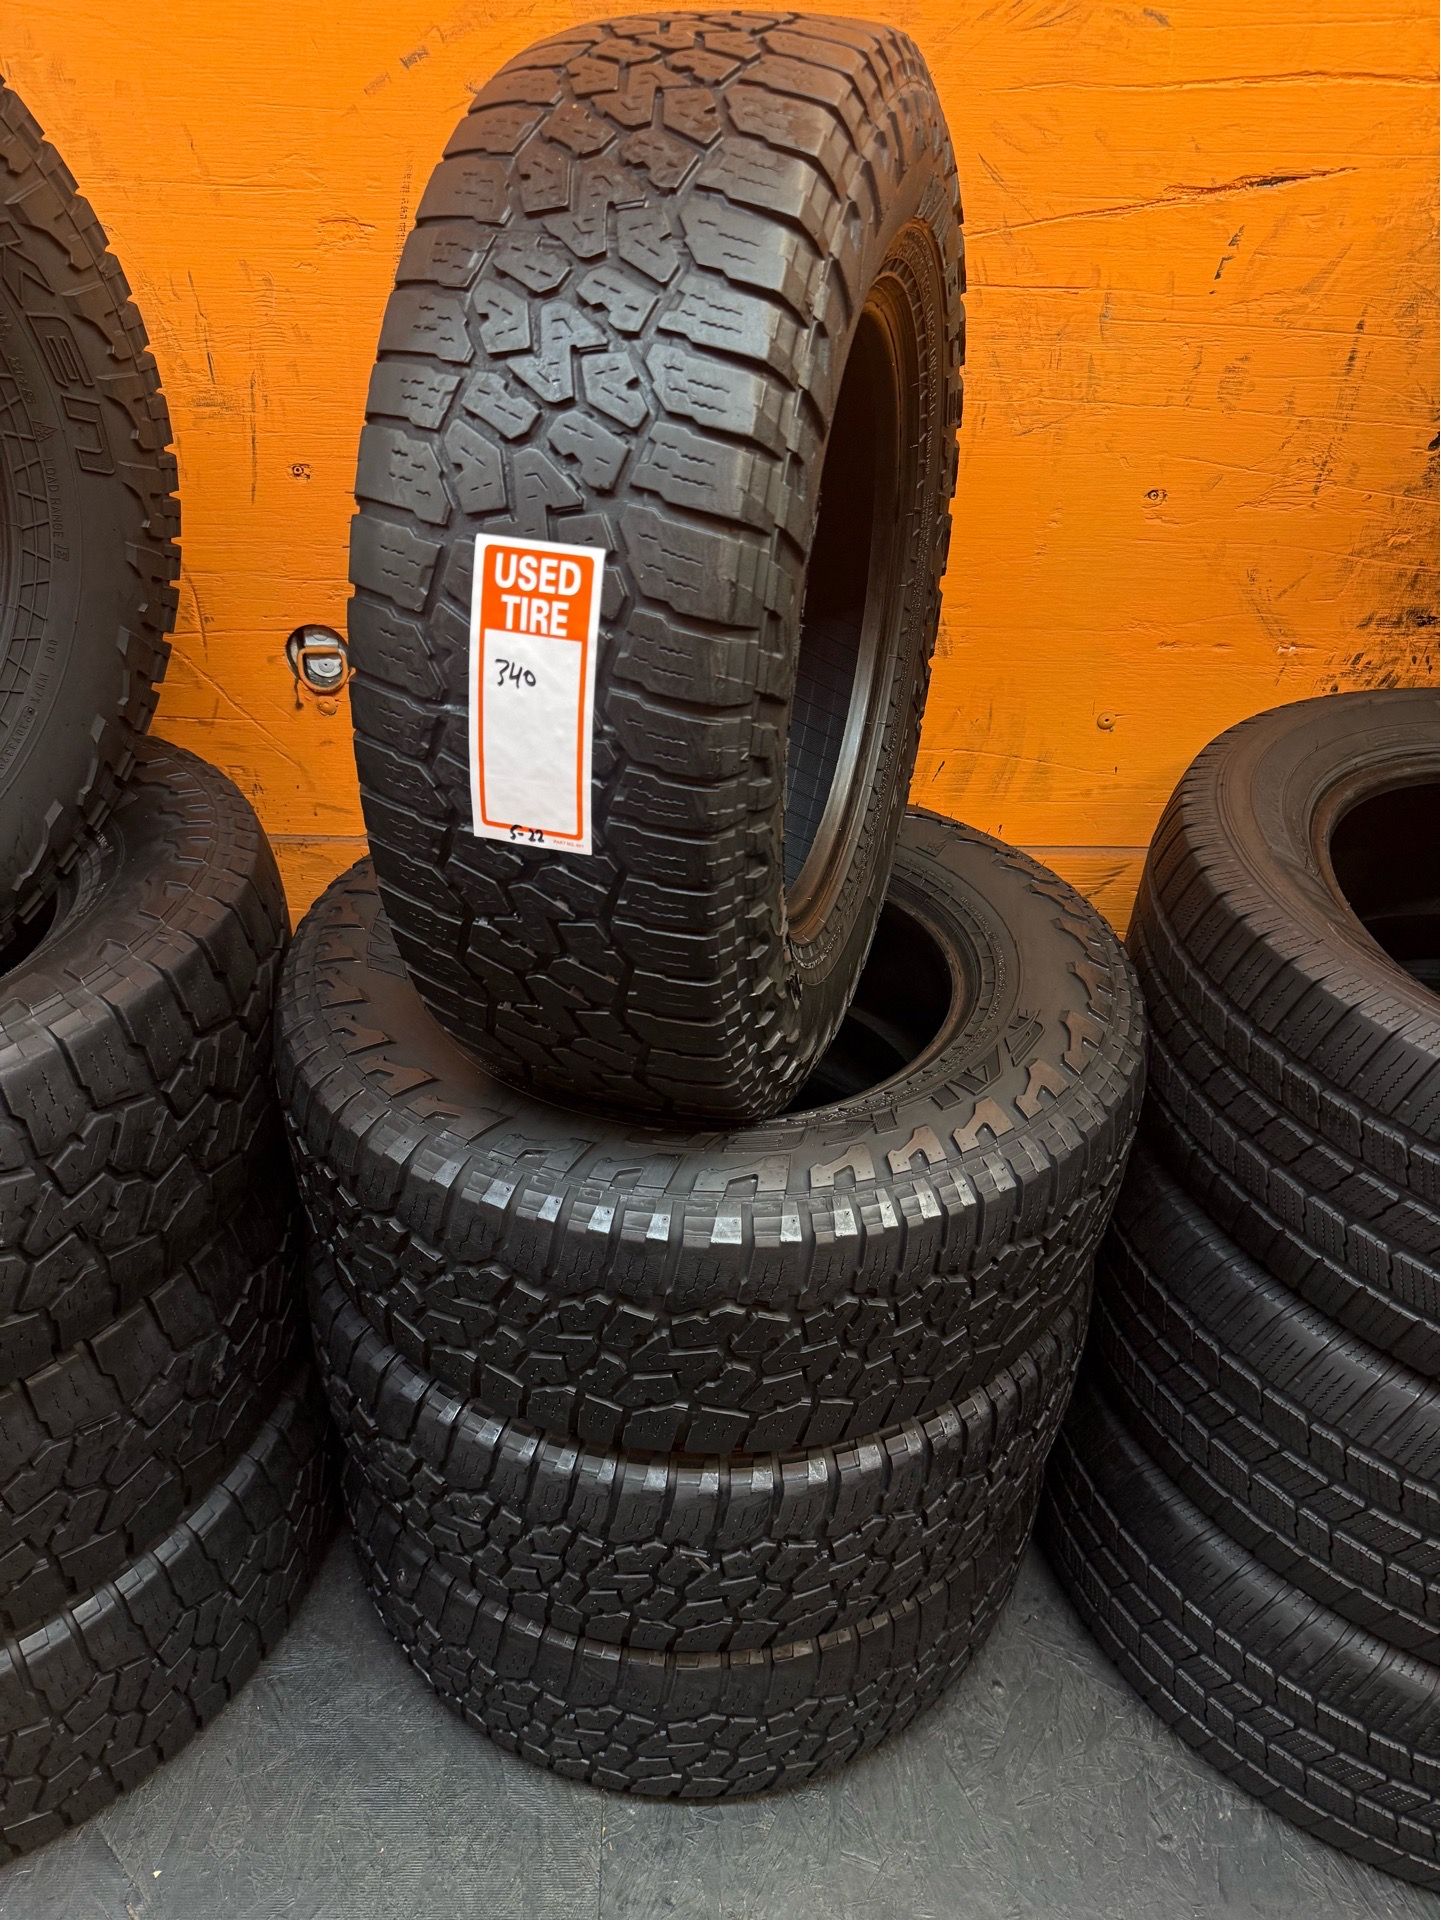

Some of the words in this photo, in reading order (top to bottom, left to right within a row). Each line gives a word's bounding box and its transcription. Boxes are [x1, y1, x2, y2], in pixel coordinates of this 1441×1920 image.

[494, 552, 582, 596] USED
[500, 594, 570, 637] TIRE
[495, 658, 536, 689] 340
